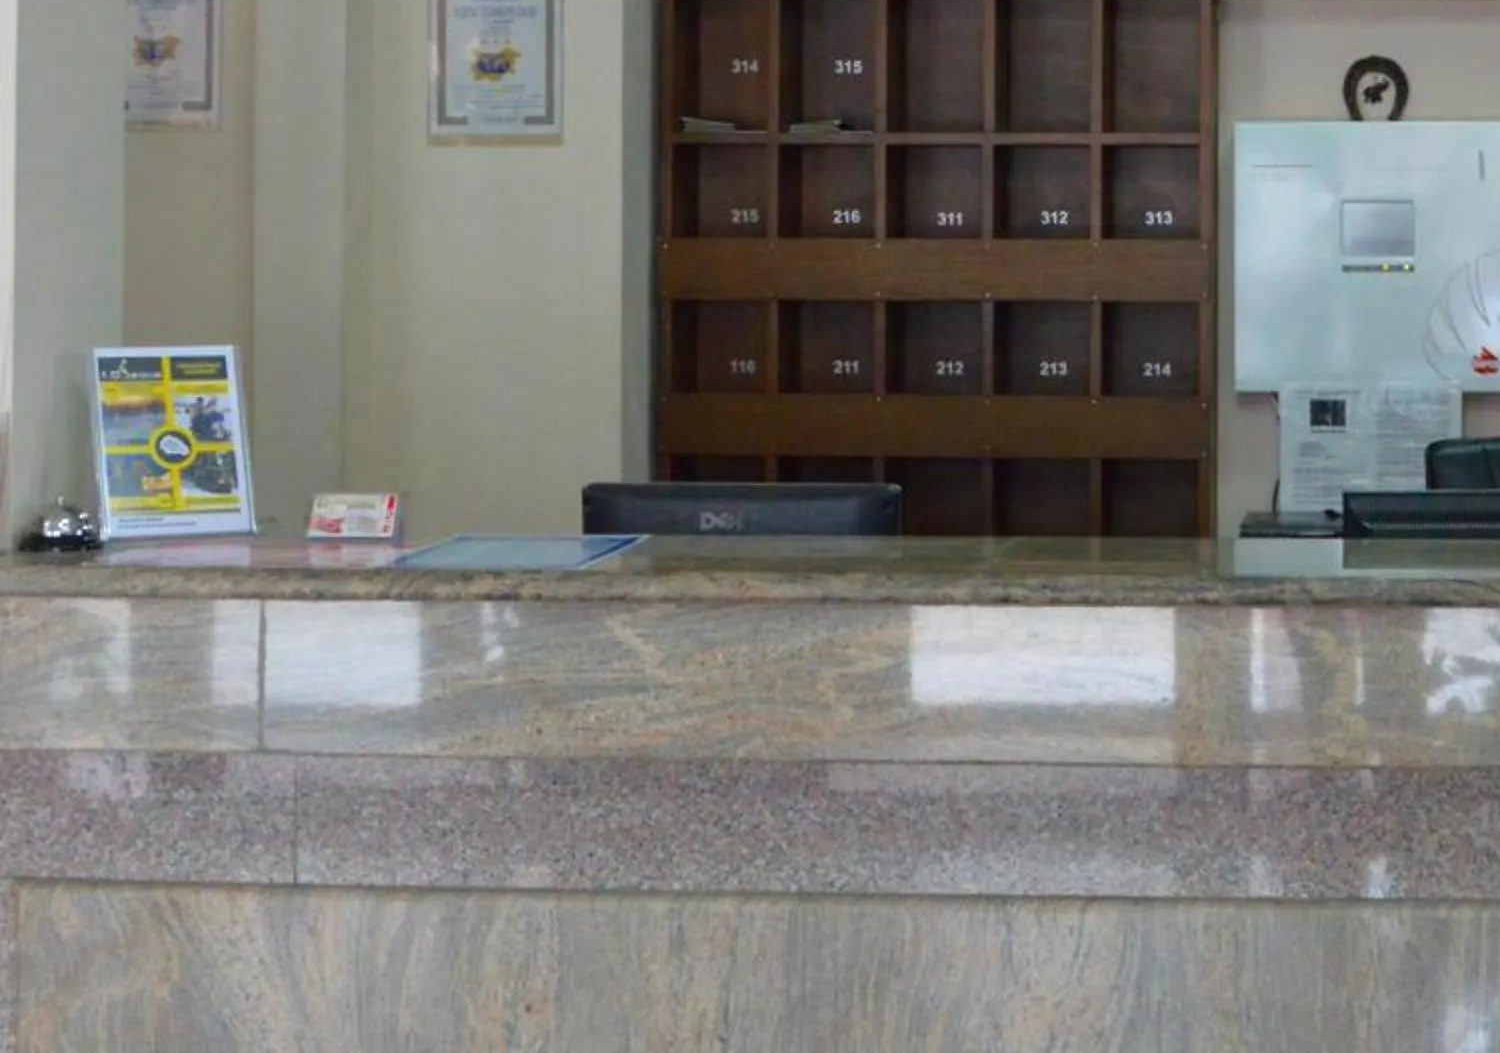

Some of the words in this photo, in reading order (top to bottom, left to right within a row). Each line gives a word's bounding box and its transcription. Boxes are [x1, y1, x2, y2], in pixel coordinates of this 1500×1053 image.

[731, 58, 759, 74] 314
[835, 59, 863, 75] 315
[730, 207, 760, 224] 215
[833, 209, 861, 224] 216
[937, 211, 963, 226] 311
[1041, 210, 1069, 225] 312
[1145, 210, 1174, 225] 313
[730, 359, 757, 374] 116
[832, 359, 860, 374] 211
[936, 360, 964, 376] 212
[1039, 360, 1068, 376] 213
[1143, 362, 1172, 377] 214
